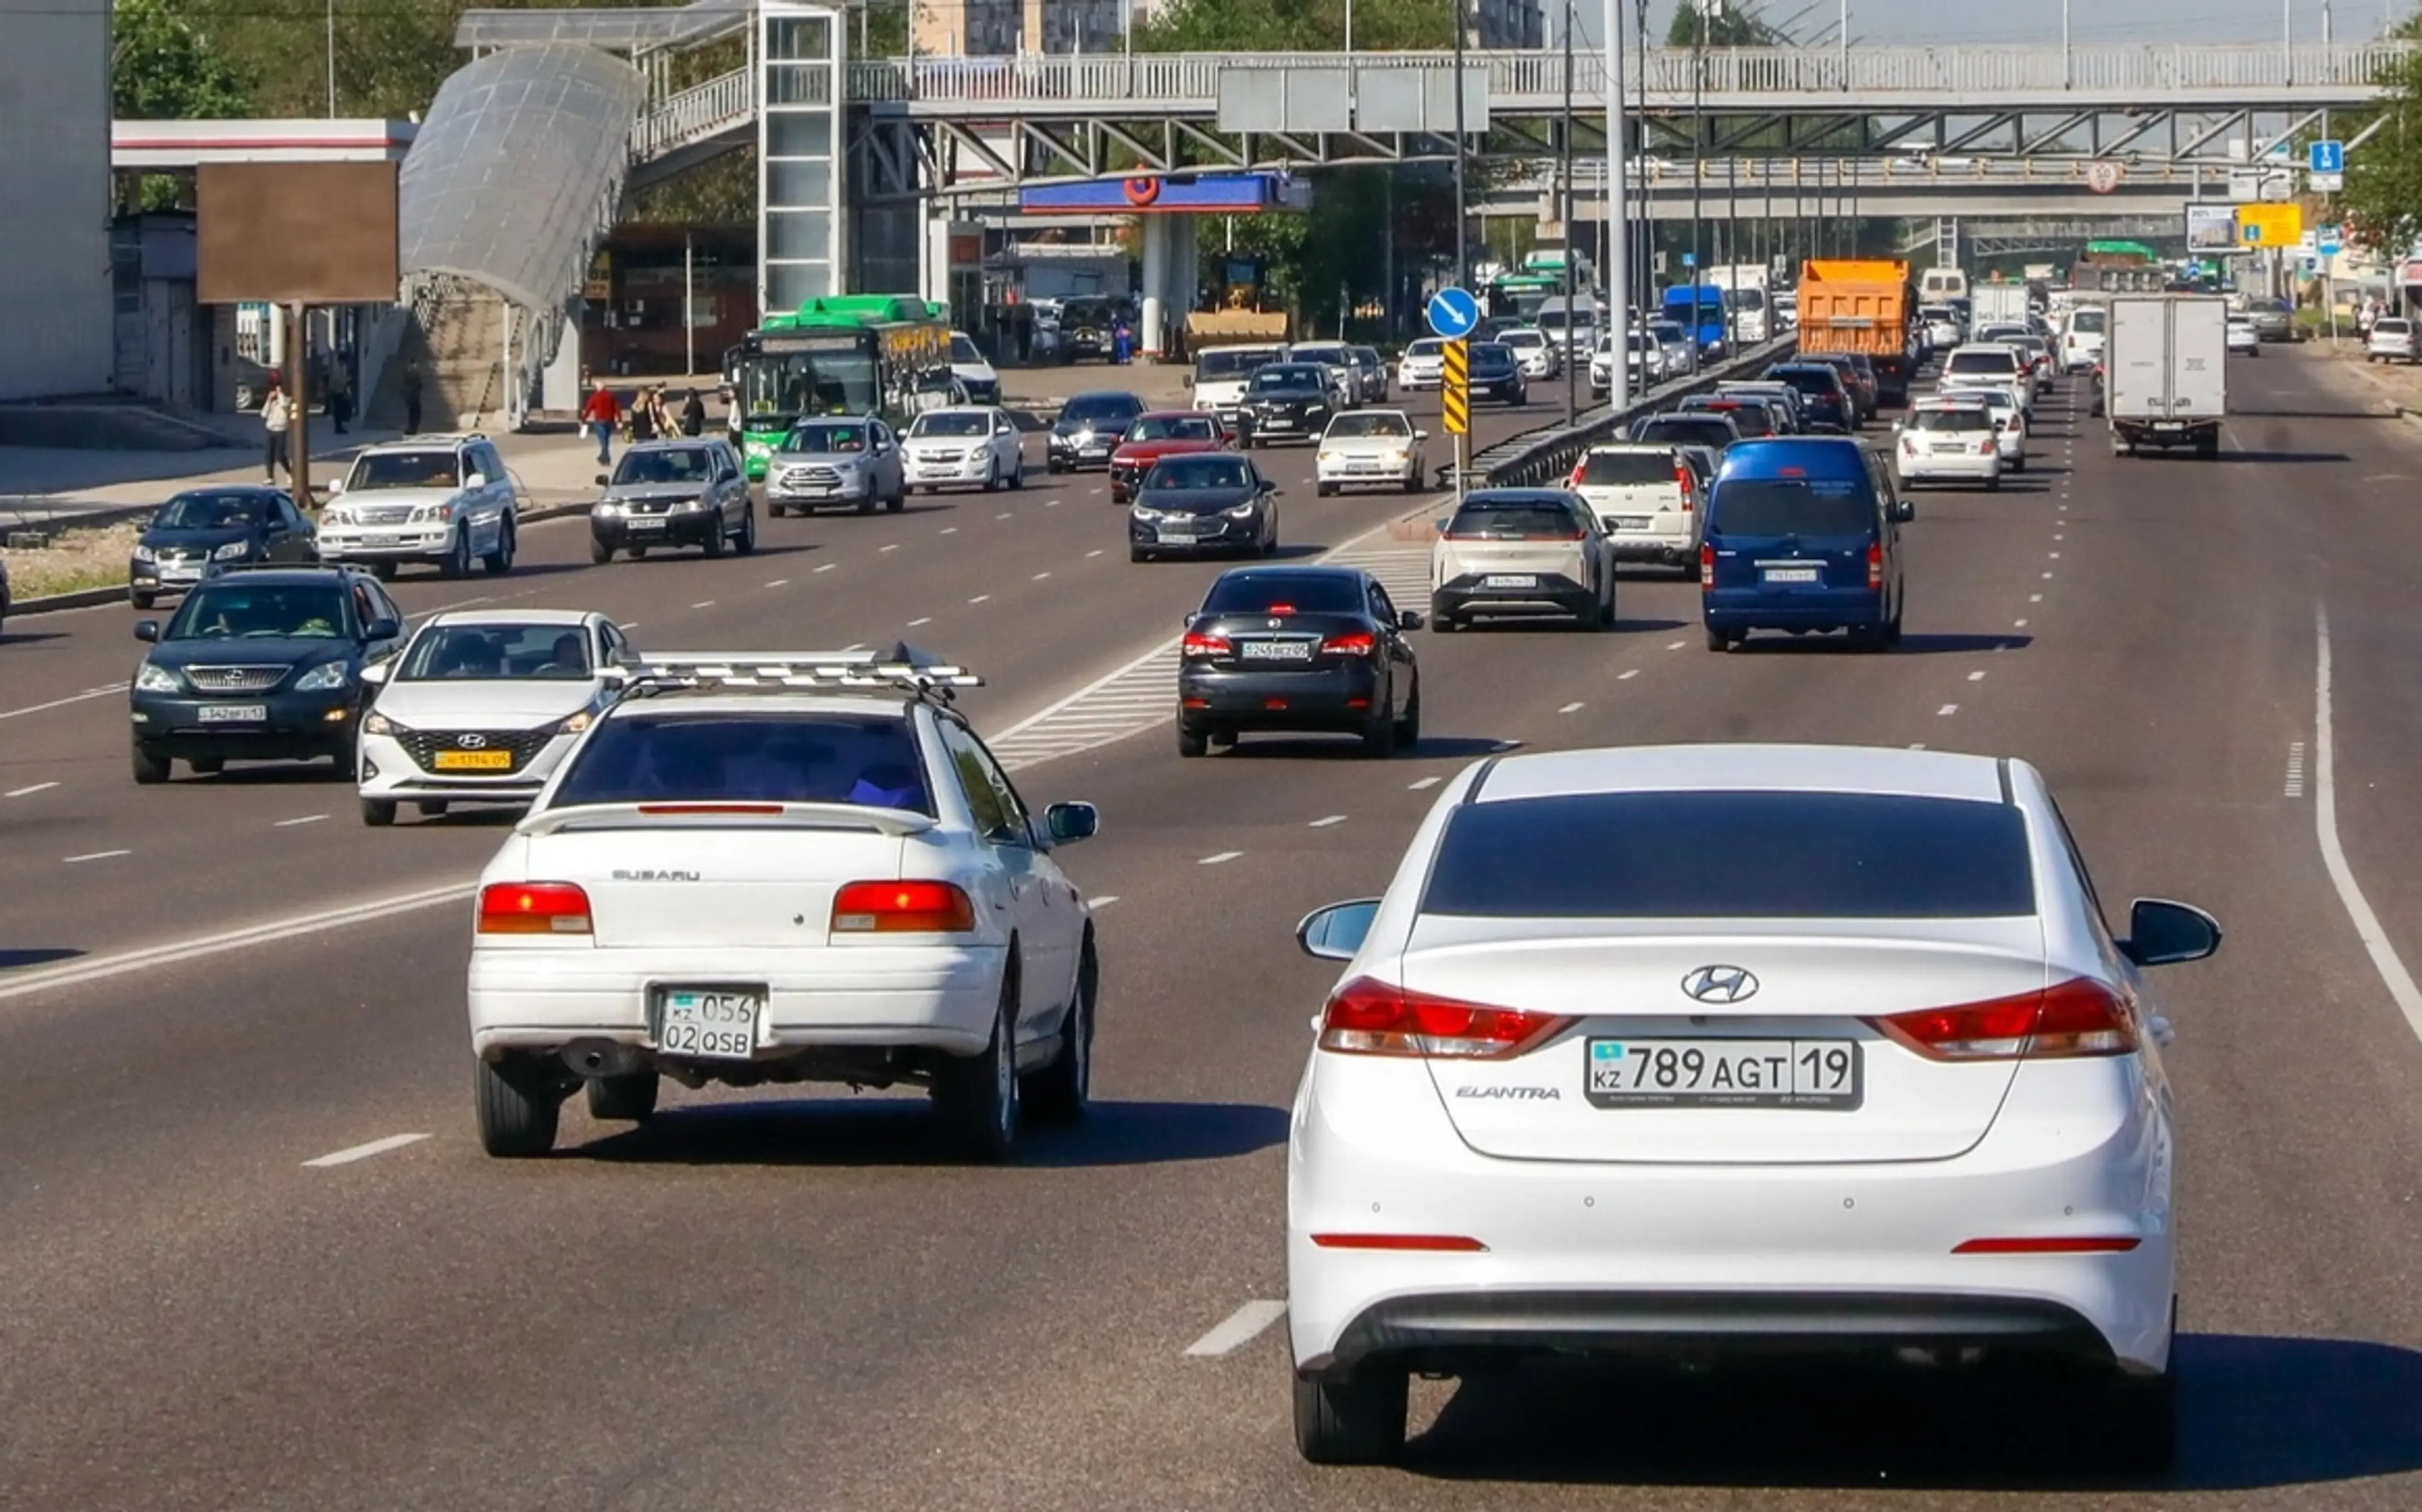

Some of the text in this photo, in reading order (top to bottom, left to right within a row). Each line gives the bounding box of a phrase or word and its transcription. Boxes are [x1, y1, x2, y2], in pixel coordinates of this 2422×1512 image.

[612, 869, 700, 881] SUBARU
[703, 995, 751, 1023] 056
[666, 1025, 748, 1053] 02 QSB
[1594, 1049, 1849, 1088] KZ 789 AGT 19
[1456, 1086, 1560, 1100] ELANTRA
